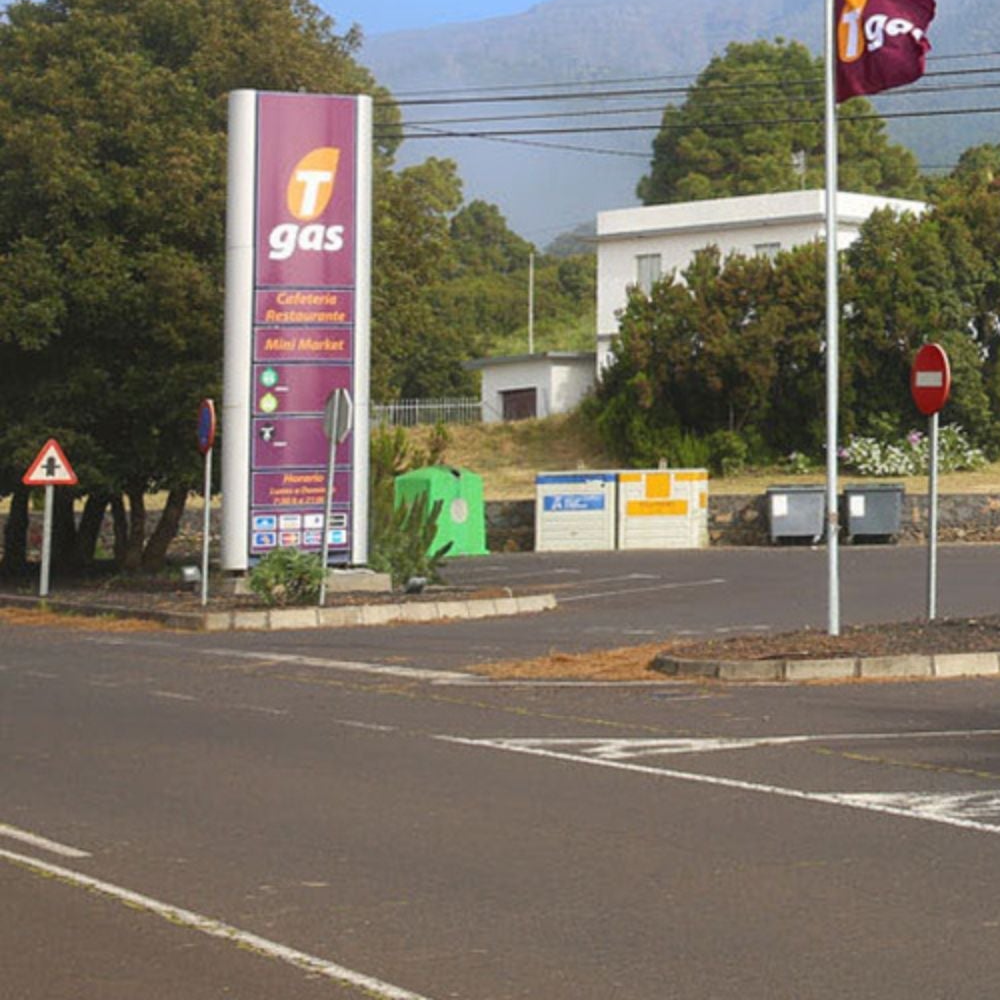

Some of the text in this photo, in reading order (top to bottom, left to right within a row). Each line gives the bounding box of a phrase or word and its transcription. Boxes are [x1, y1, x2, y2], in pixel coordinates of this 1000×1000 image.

[295, 170, 333, 217] T
[268, 223, 345, 260] gas
[265, 309, 345, 322] Restaurante
[265, 338, 345, 351] Mini Market
